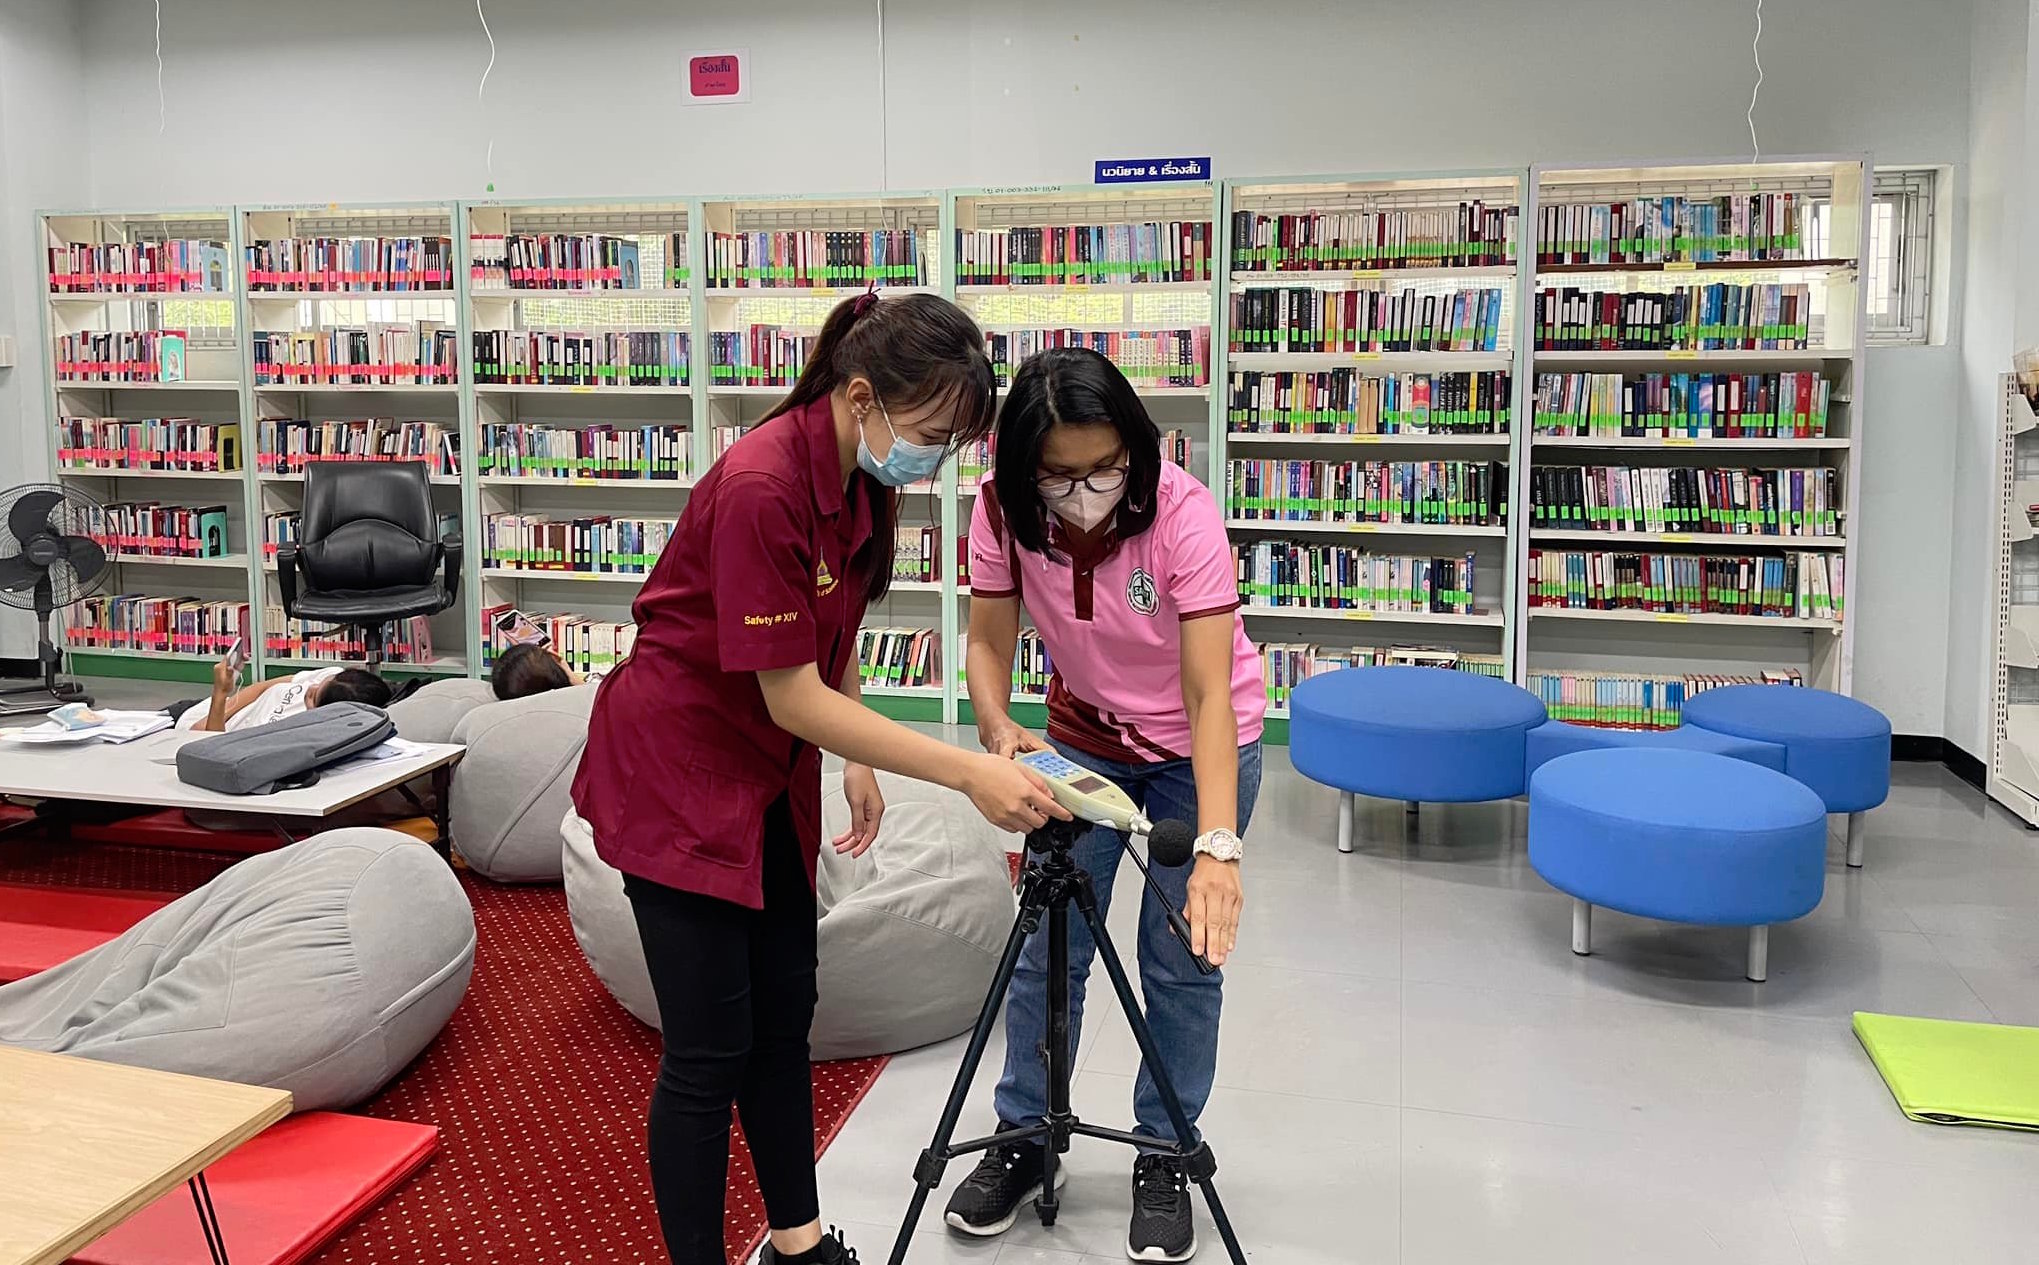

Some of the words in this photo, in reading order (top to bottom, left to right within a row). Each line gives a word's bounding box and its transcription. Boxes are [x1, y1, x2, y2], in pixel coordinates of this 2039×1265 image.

[1102, 166, 1145, 177] นวนิยาย
[1148, 166, 1158, 176] &
[1161, 160, 1201, 176] เรื่องสั้น
[783, 611, 798, 623] XIV
